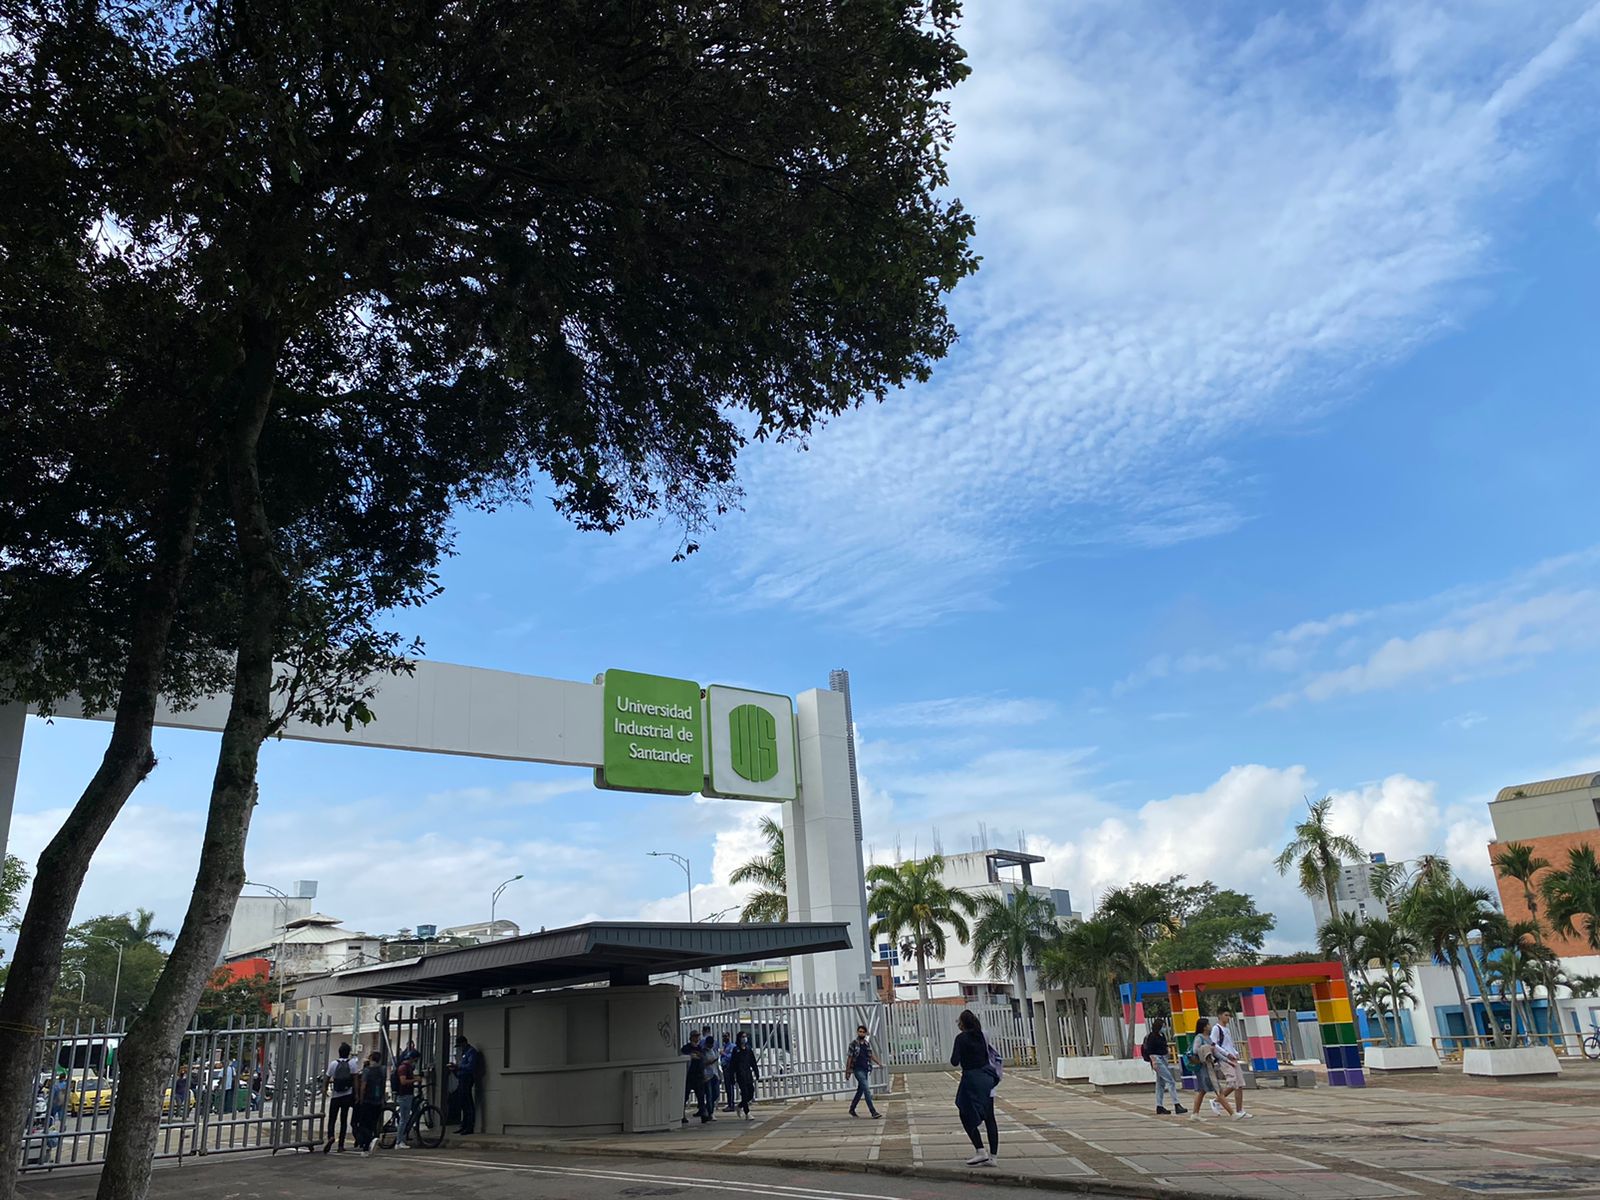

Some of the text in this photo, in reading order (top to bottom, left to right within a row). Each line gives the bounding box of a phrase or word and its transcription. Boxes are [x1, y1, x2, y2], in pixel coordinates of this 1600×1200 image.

[617, 696, 692, 720] Universidad
[614, 718, 694, 742] Industrial de
[629, 743, 694, 765] Santander
